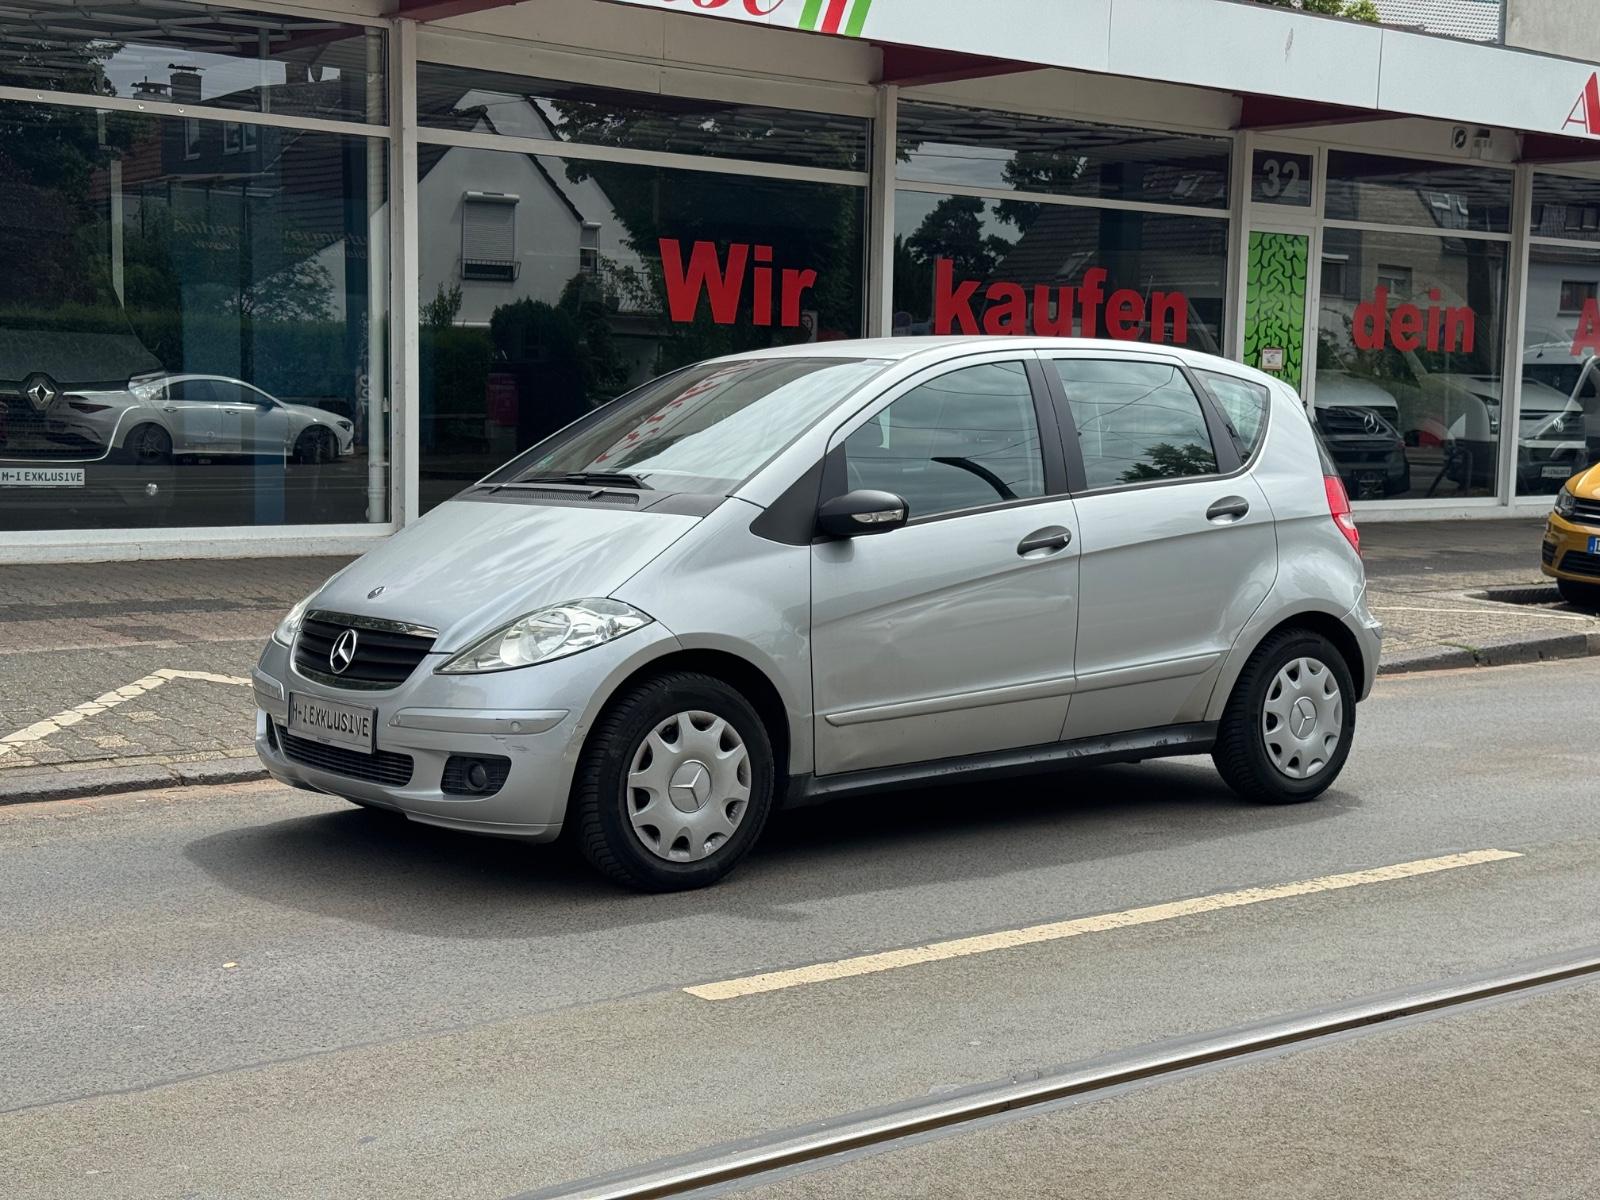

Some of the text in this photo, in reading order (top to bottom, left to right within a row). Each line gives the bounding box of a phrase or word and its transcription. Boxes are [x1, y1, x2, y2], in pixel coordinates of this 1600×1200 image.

[1261, 159, 1300, 197] 32
[658, 238, 817, 327] Wir
[934, 257, 1188, 343] kaufen
[1353, 284, 1475, 353] dein
[24, 471, 83, 482] EXKLUSIVE
